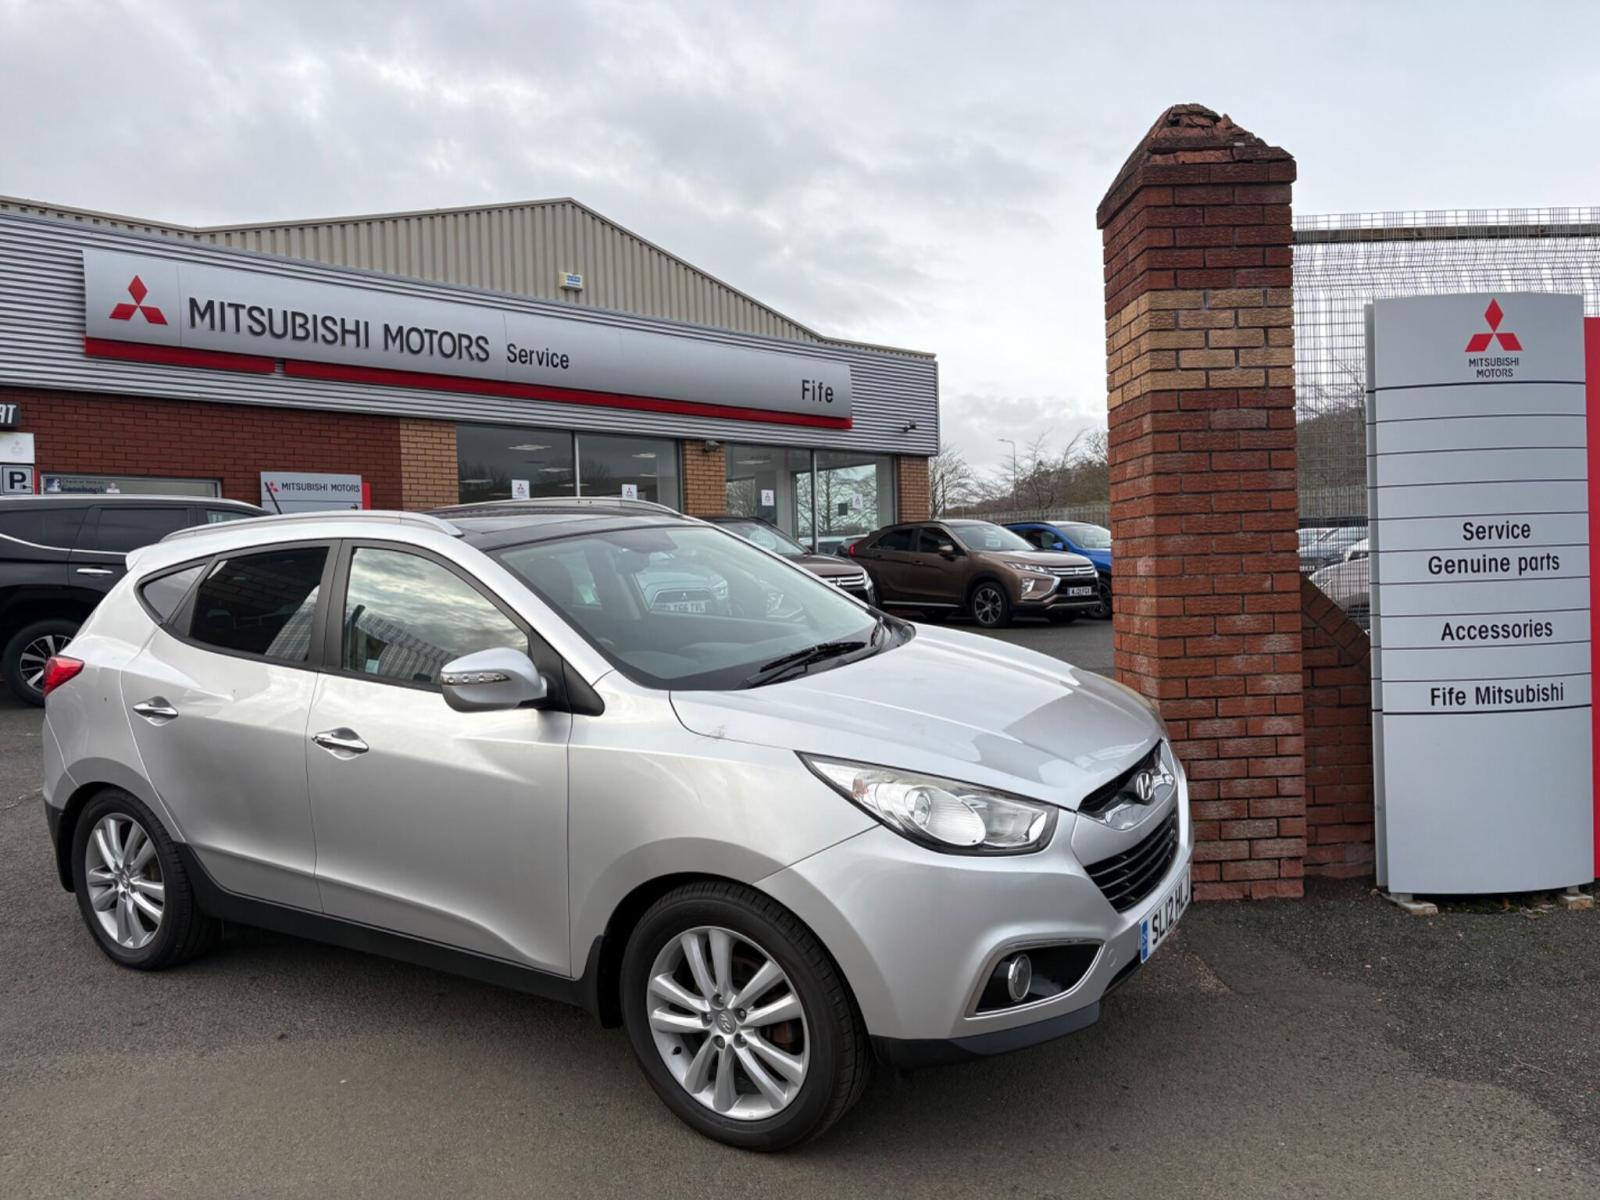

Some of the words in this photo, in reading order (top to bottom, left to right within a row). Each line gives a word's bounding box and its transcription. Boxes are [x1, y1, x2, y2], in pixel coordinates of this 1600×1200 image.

[189, 297, 370, 349] MITSUBISHI
[383, 323, 490, 363] MOTORS
[507, 343, 570, 369] Service
[1468, 357, 1520, 368] MITSUBISHI
[1476, 368, 1514, 378] MOTORS
[802, 379, 834, 403] Fife
[9, 471, 27, 489] P
[281, 482, 328, 492] MITSUBISHI
[331, 484, 361, 493] MOTORS
[1462, 520, 1531, 541] Service
[1428, 554, 1511, 575] Genuine
[1518, 552, 1560, 576] parts
[1441, 619, 1553, 641] Accessories
[1430, 687, 1467, 706] Fife
[1475, 682, 1564, 705] Mitsubishi
